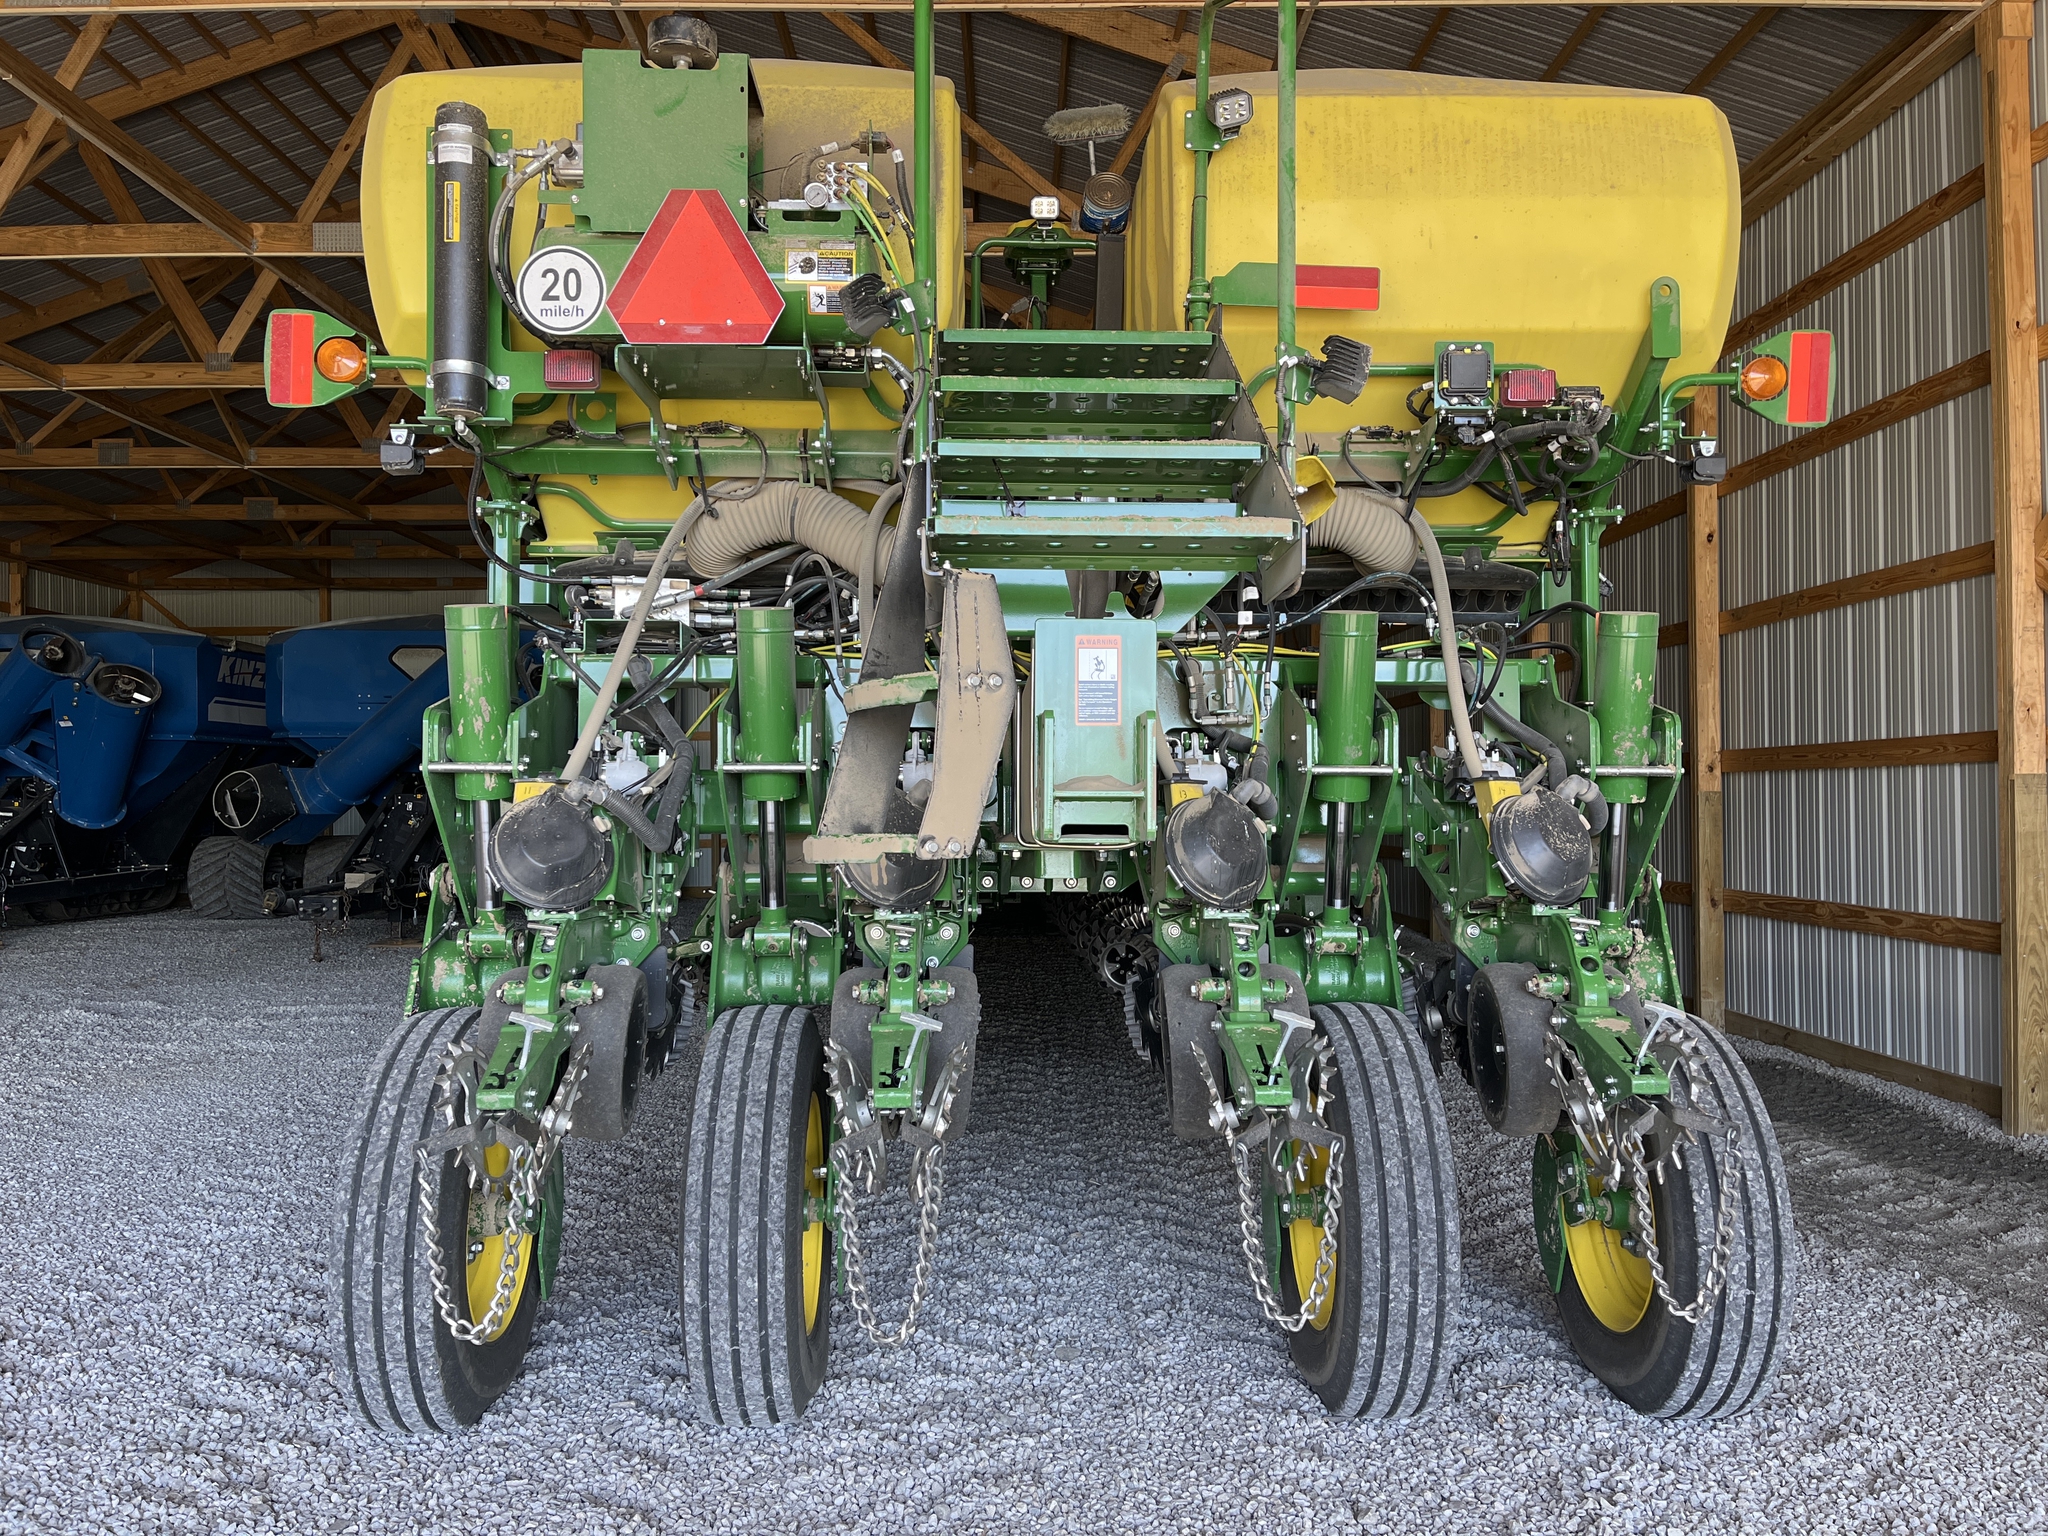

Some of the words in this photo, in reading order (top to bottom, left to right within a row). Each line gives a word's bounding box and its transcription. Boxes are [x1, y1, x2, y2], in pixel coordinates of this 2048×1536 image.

[541, 268, 582, 302] 20
[540, 305, 584, 317] mile/h
[217, 655, 266, 689] KINZ
[1180, 790, 1187, 798] 13
